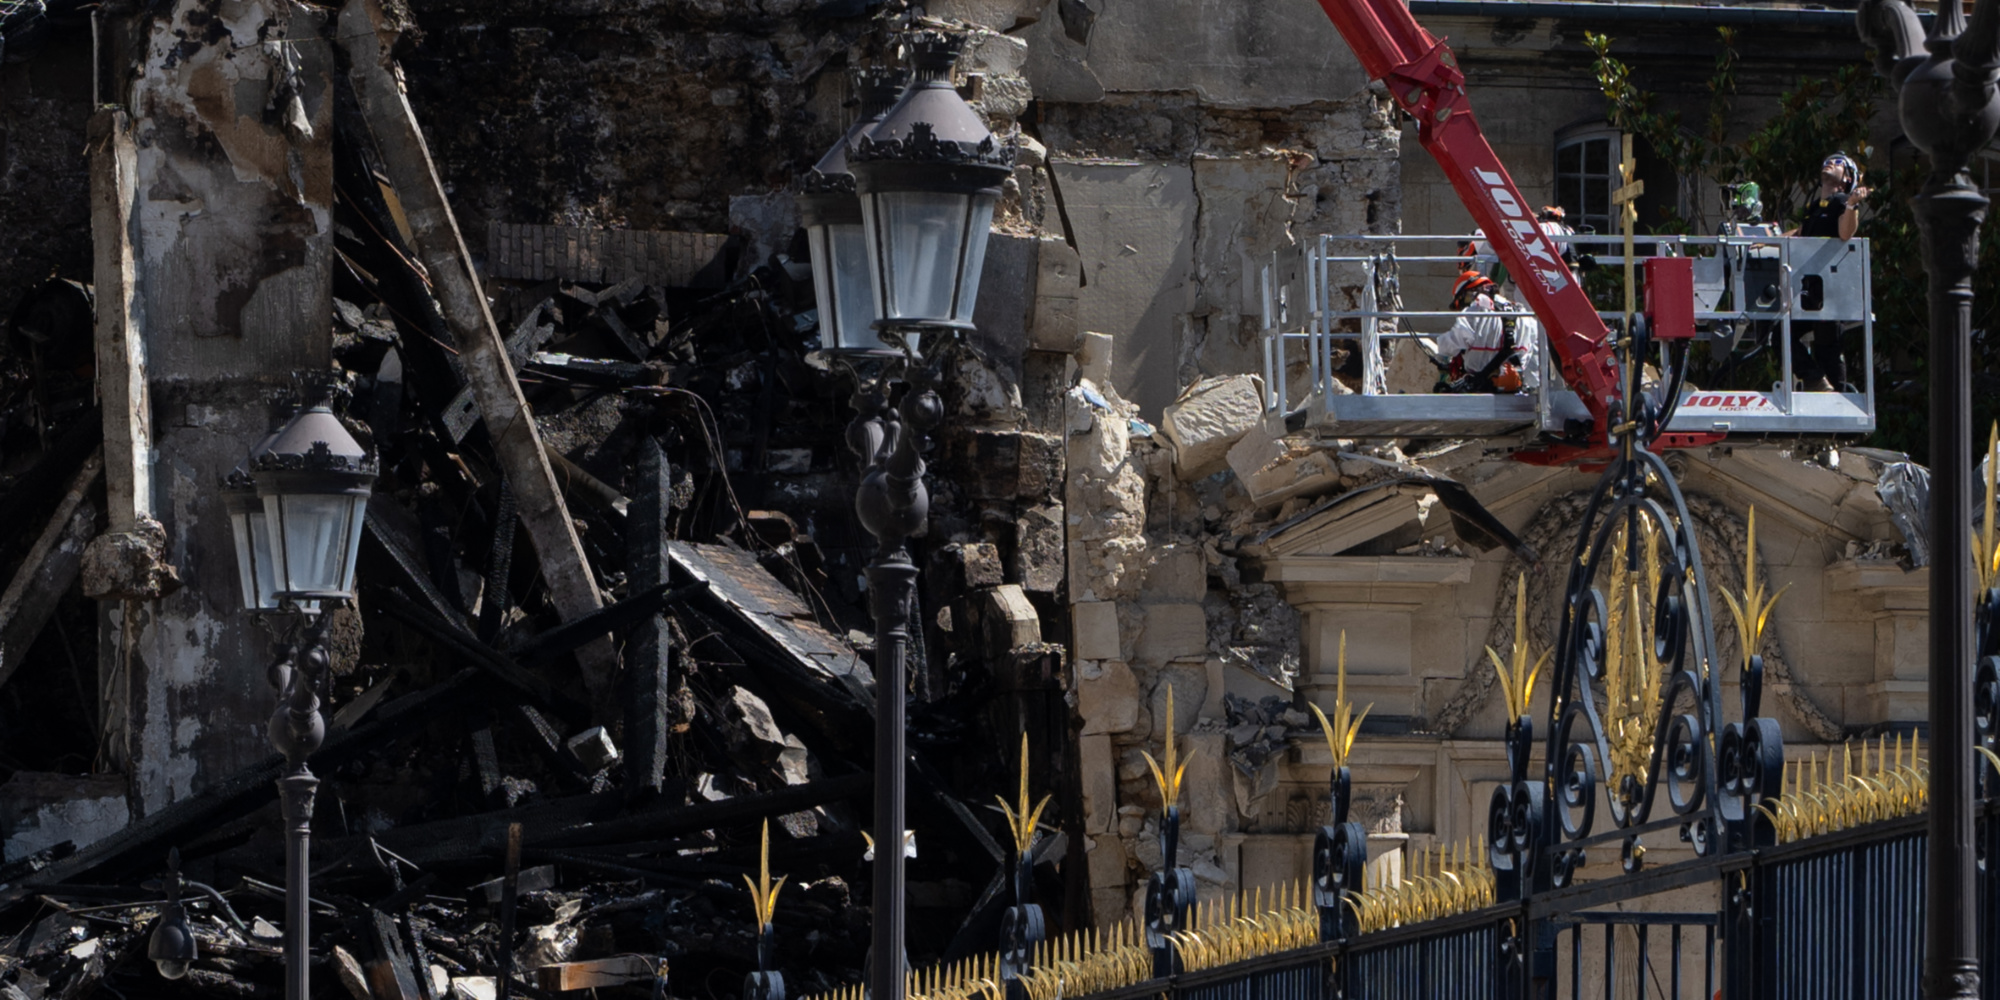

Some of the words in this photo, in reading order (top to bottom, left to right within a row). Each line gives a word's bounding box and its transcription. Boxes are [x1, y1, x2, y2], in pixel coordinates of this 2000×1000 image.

[1474, 166, 1557, 265] JOLY
[1501, 219, 1555, 294] LOCATION
[1682, 395, 1758, 407] JOLY
